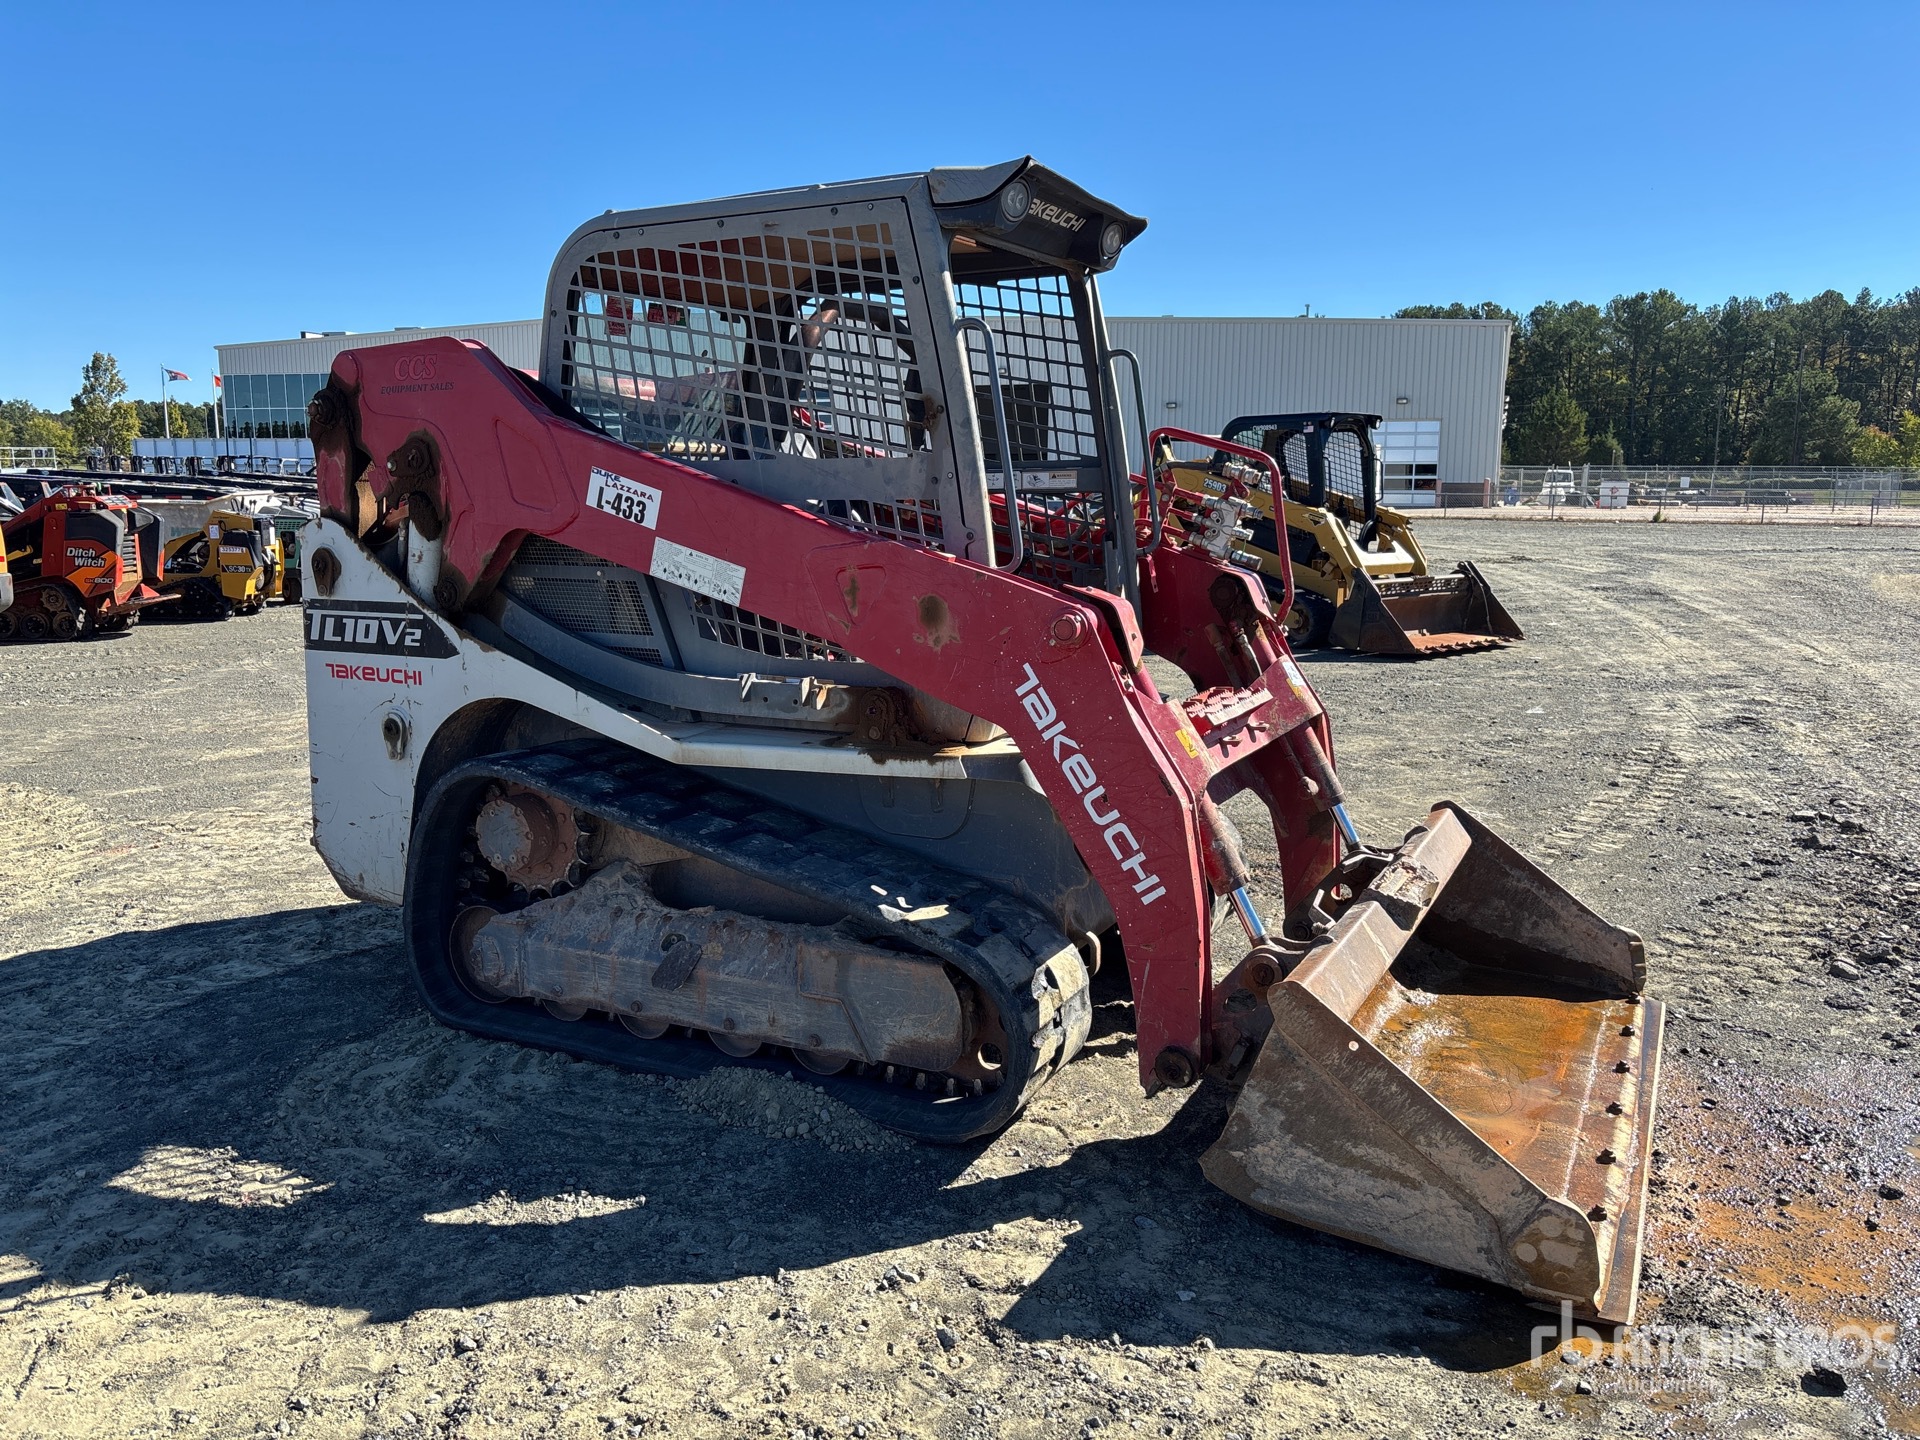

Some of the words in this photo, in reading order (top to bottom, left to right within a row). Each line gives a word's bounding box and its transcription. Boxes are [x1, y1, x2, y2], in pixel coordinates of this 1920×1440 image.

[1028, 198, 1087, 232] AKEUCHI
[394, 354, 437, 381] CCS
[381, 383, 428, 395] EQUIPMENT
[430, 382, 454, 392] SALES
[591, 467, 621, 482] DUKE
[605, 480, 654, 502] LAZZARA
[1203, 478, 1226, 493] 259D3
[596, 486, 646, 524] L-433
[66, 547, 96, 557] Ditch
[74, 557, 105, 567] Witch
[228, 565, 246, 573] SC30
